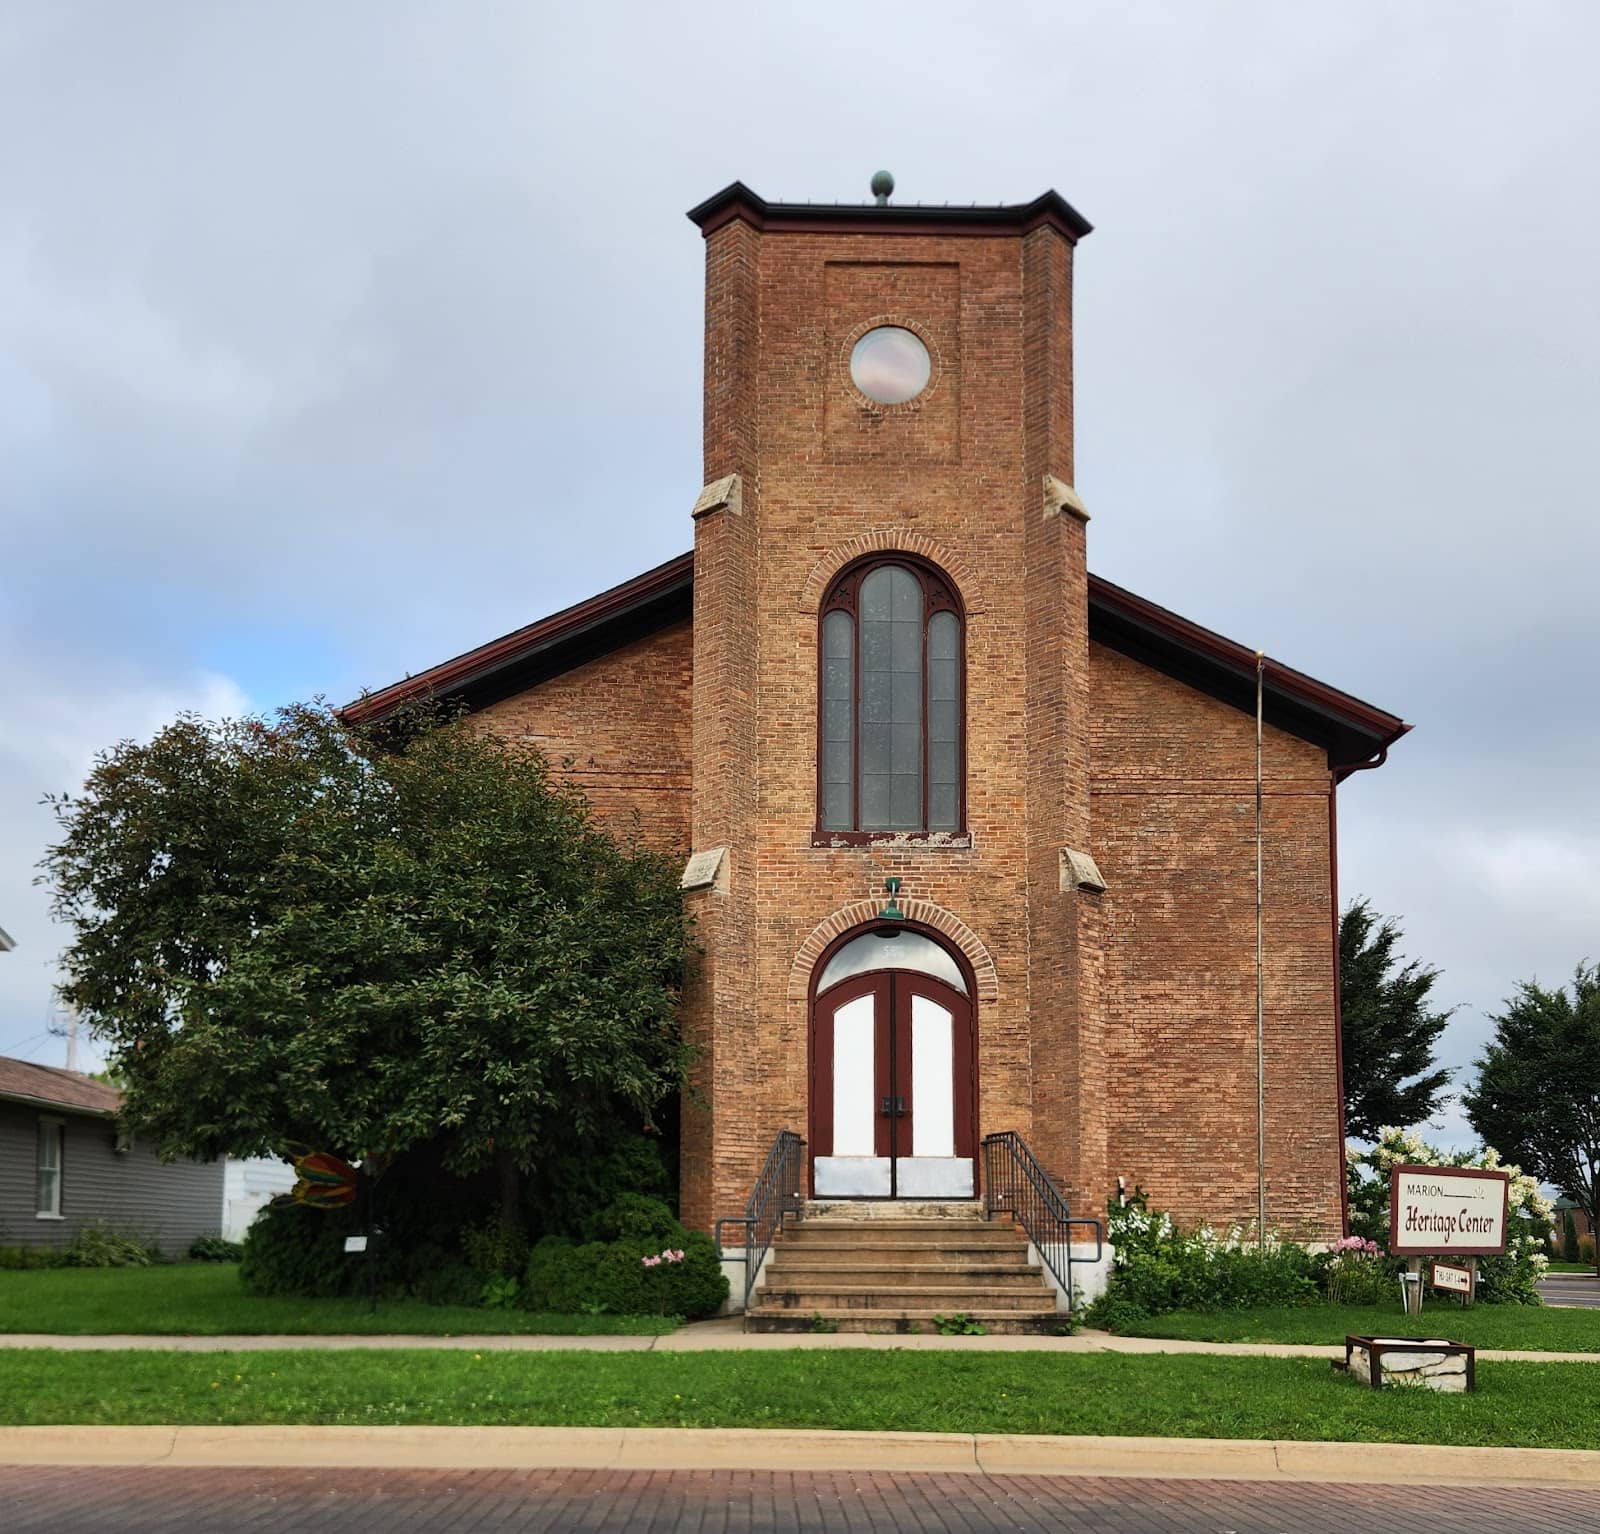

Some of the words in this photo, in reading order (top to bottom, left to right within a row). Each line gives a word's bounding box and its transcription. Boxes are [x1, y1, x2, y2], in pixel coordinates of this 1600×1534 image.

[1407, 1184, 1444, 1197] MARION
[1405, 1205, 1456, 1244] Heritage
[1459, 1208, 1494, 1233] Center
